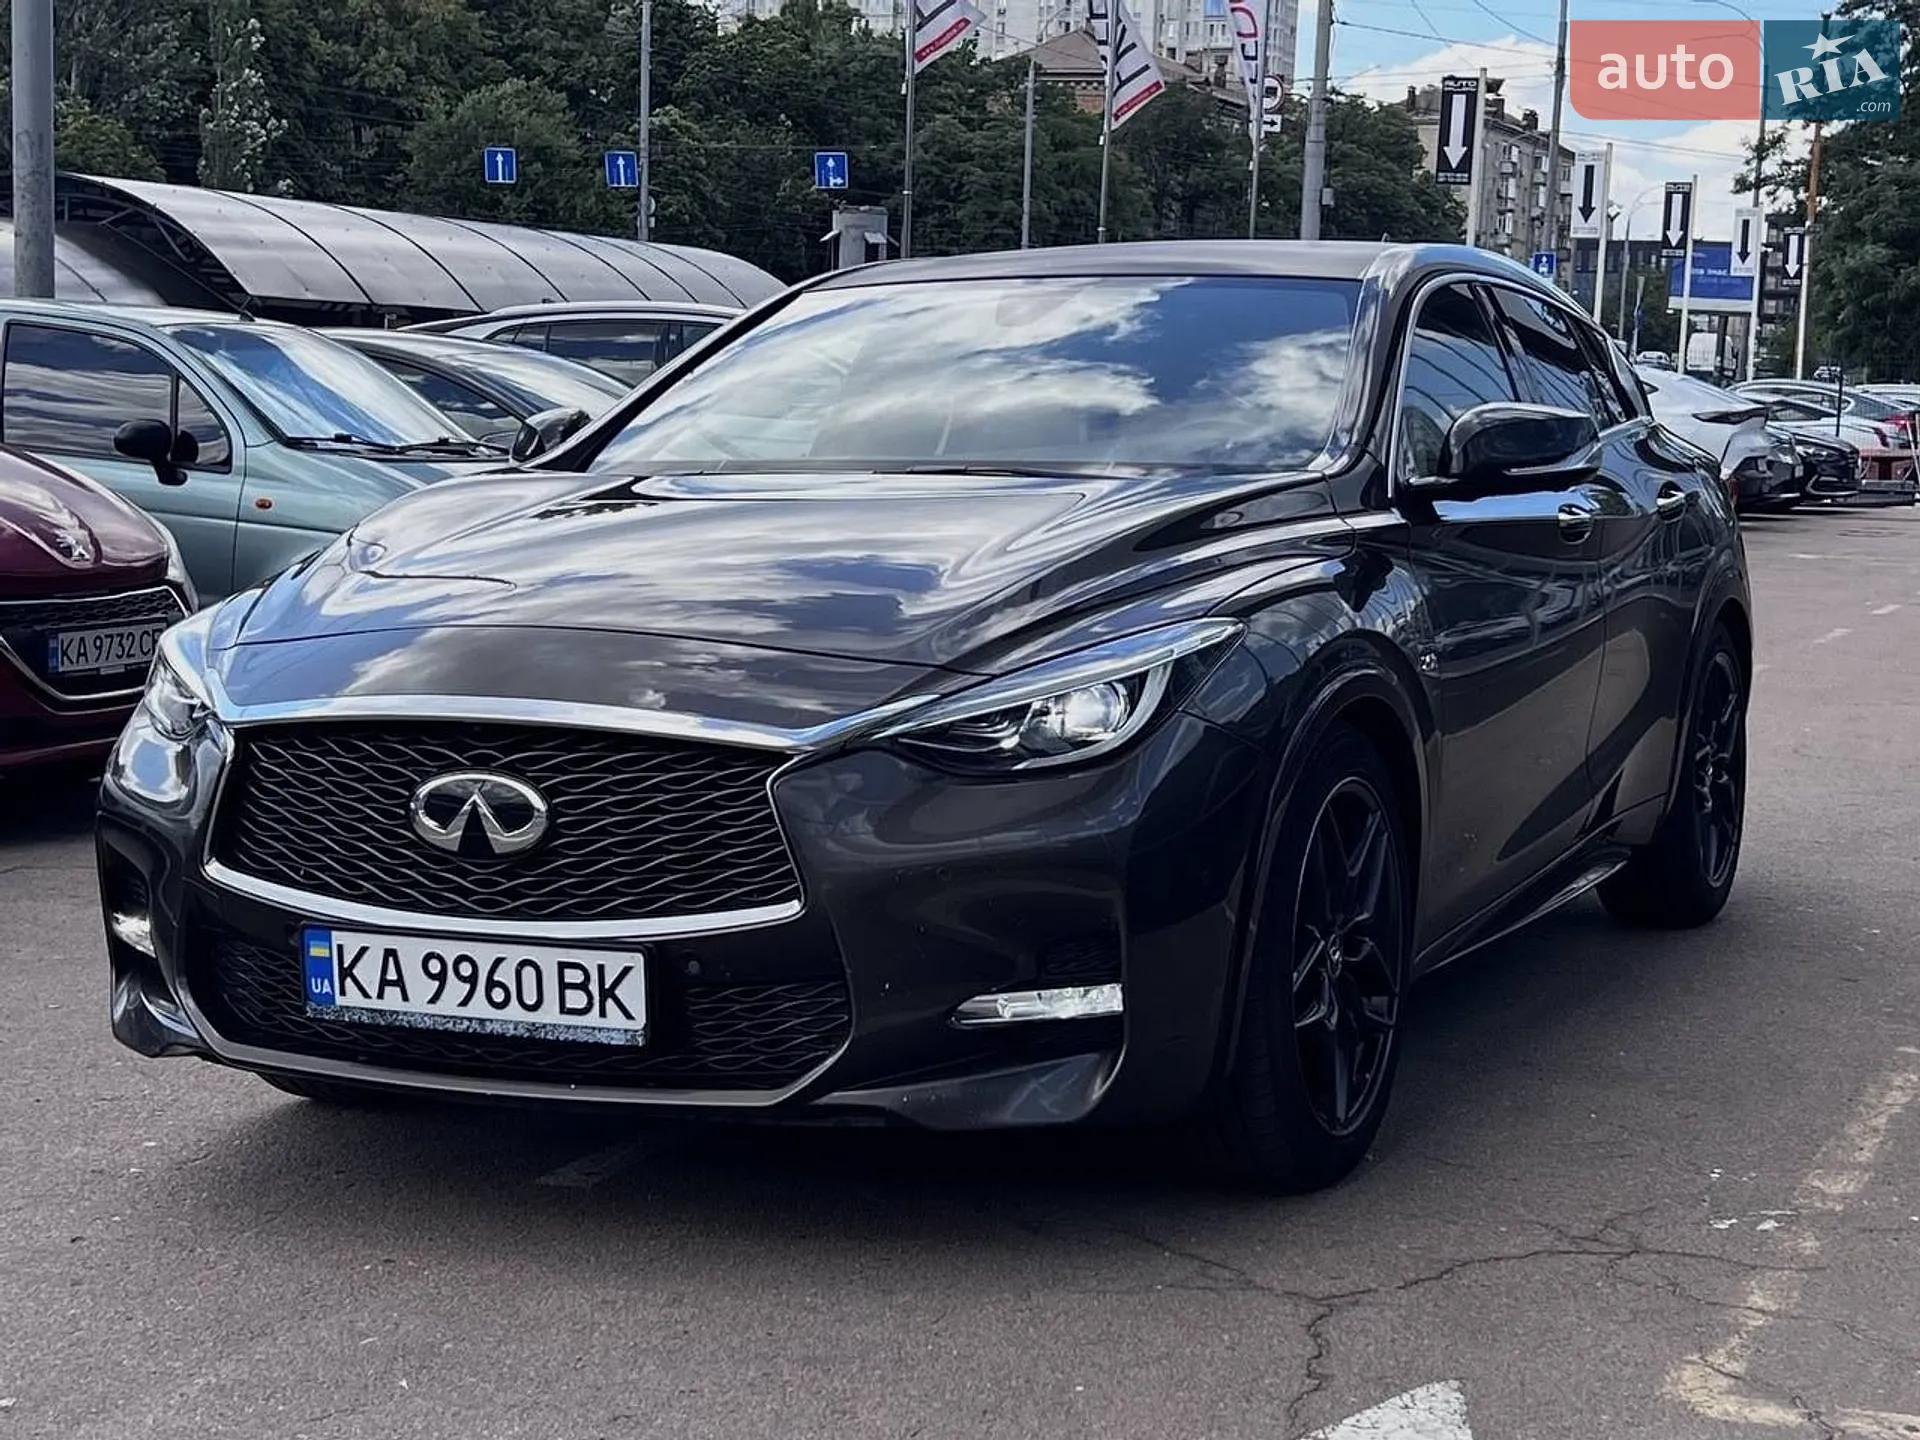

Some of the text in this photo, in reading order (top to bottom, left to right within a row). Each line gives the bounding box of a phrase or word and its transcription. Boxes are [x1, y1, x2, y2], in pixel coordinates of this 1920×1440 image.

[60, 636, 89, 666] KA
[93, 632, 135, 663] 9732
[311, 976, 332, 995] UA
[336, 943, 636, 1021] KA 9960 BK
